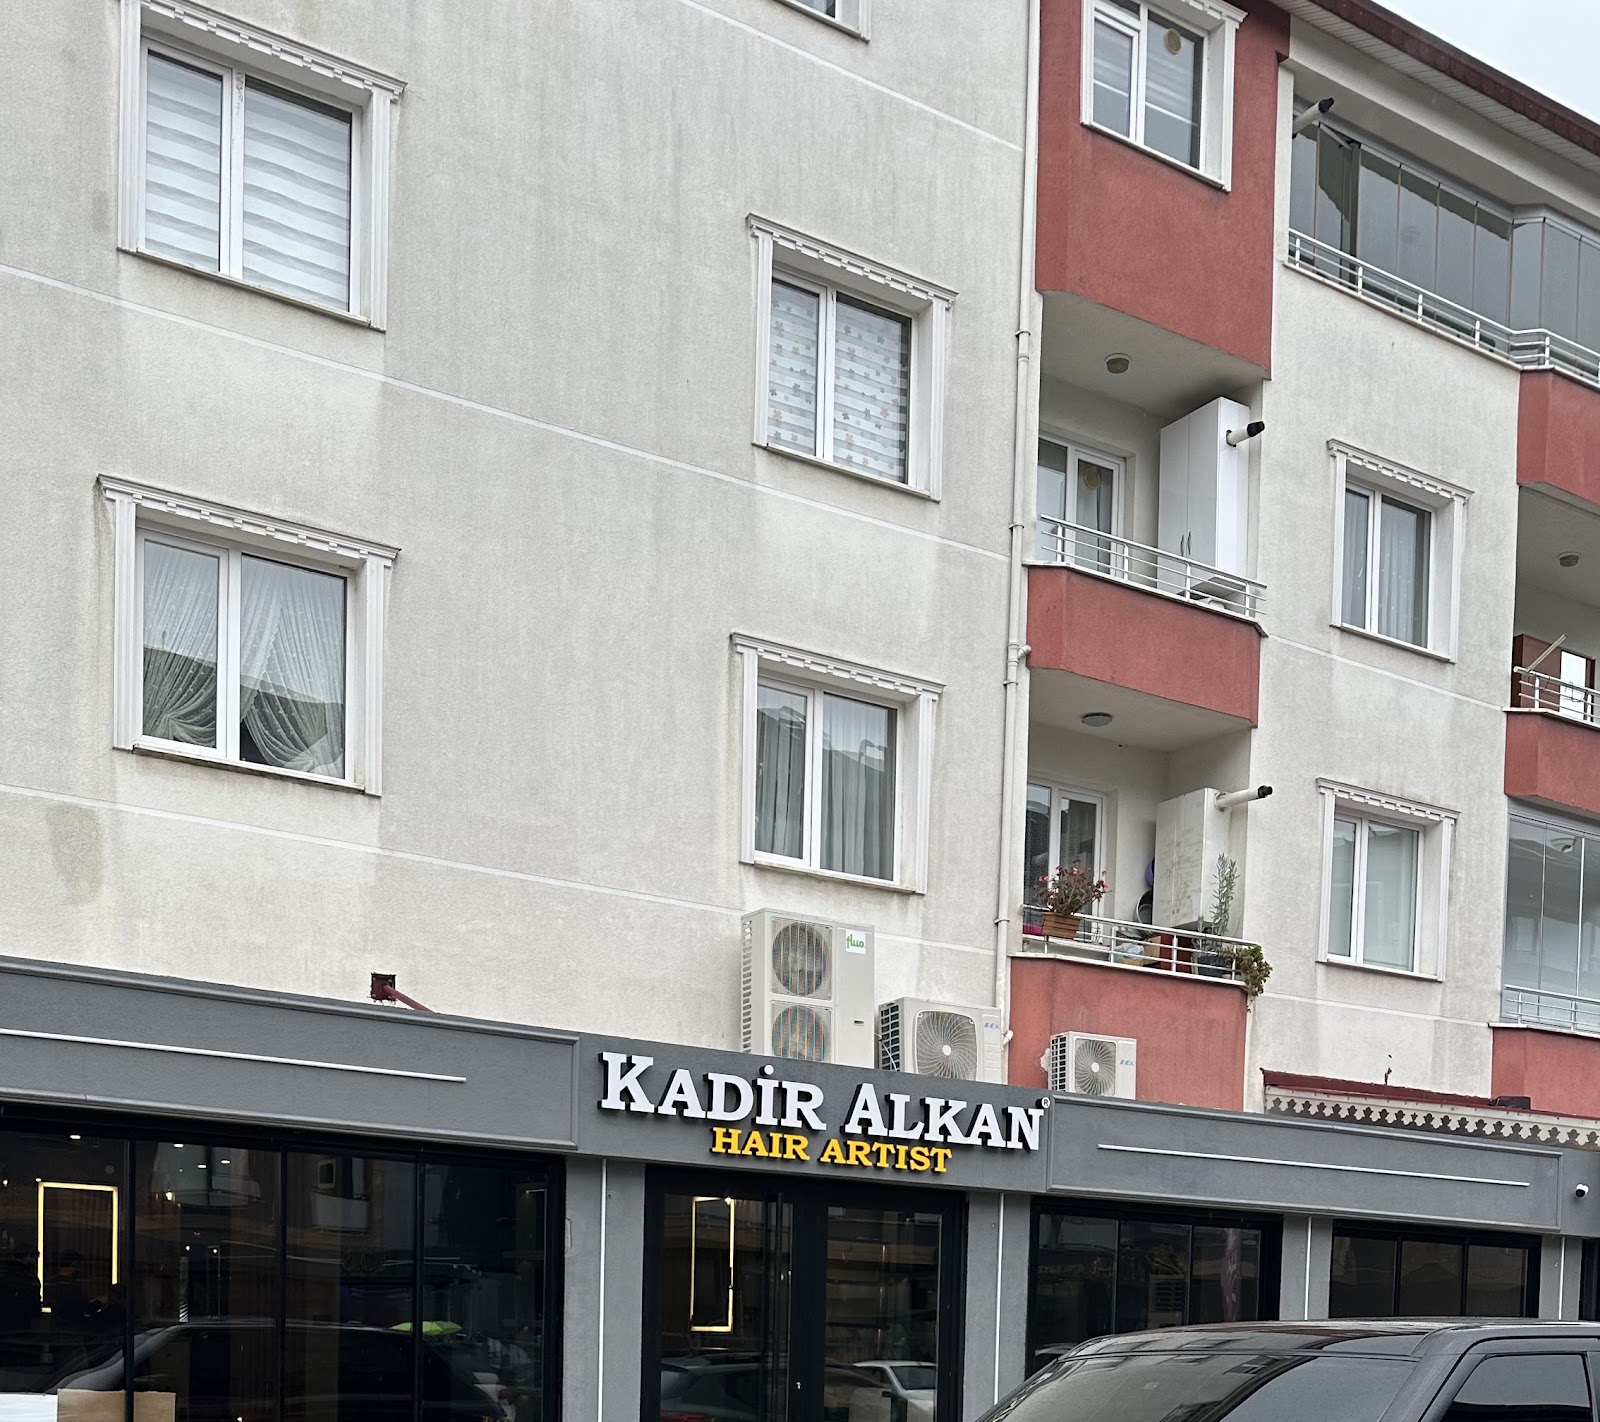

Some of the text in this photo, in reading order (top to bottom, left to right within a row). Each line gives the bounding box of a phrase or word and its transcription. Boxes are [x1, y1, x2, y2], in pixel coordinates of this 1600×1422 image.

[600, 1051, 827, 1131] KADİR
[711, 1126, 953, 1173] HAIR ARTIST
